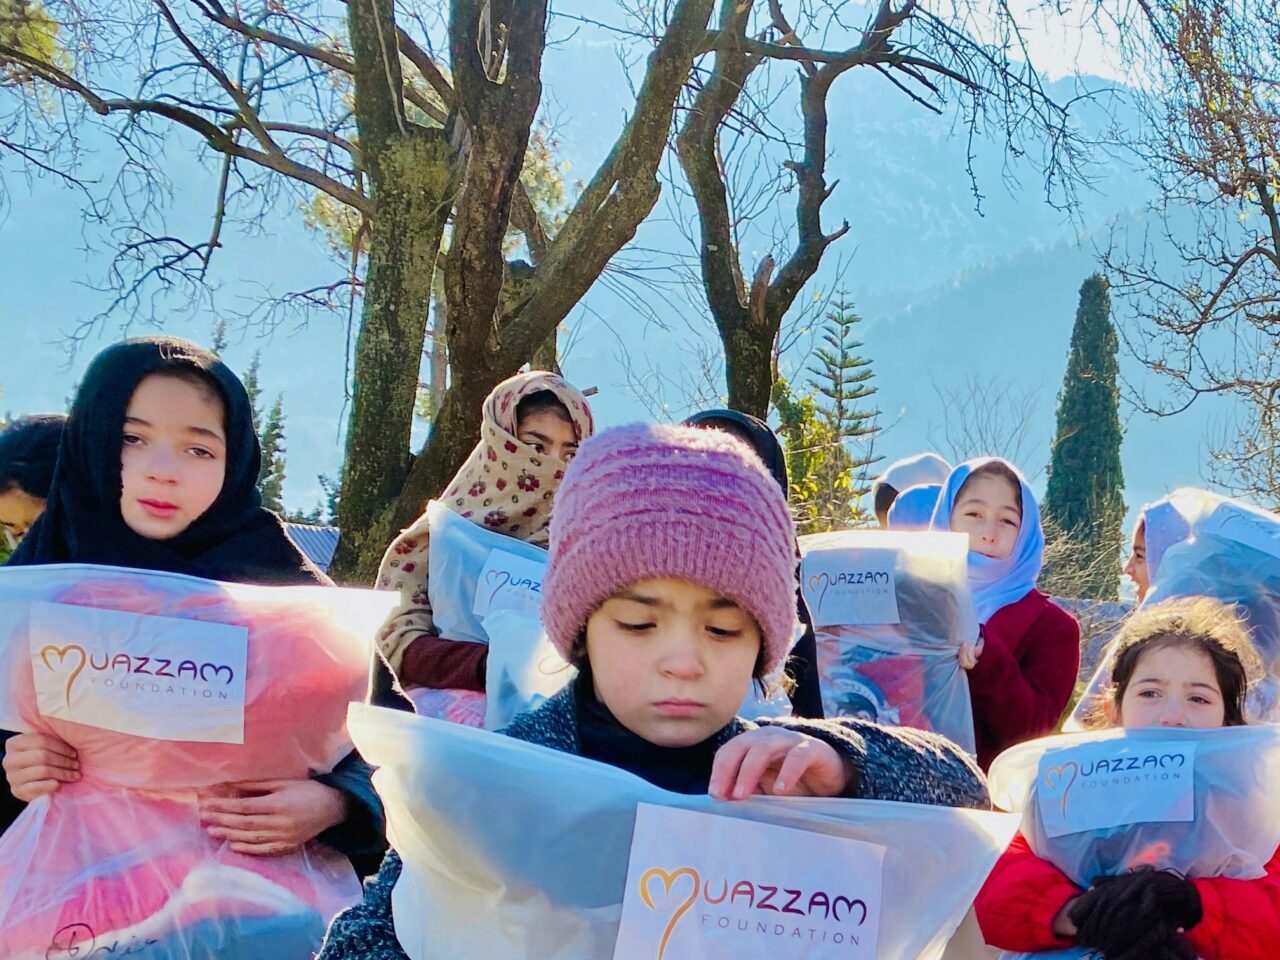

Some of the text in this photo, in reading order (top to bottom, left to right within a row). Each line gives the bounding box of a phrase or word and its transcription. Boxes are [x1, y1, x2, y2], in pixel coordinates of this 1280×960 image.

[485, 569, 542, 608] MUAZ
[808, 571, 889, 613] MUAZZAM
[40, 644, 234, 708] MUAZZAM
[91, 677, 228, 700] FOUNDATION
[1044, 753, 1185, 821] MUAZZAM
[1081, 772, 1181, 789] FOUNDATION
[702, 913, 860, 946] FOUNDATION
